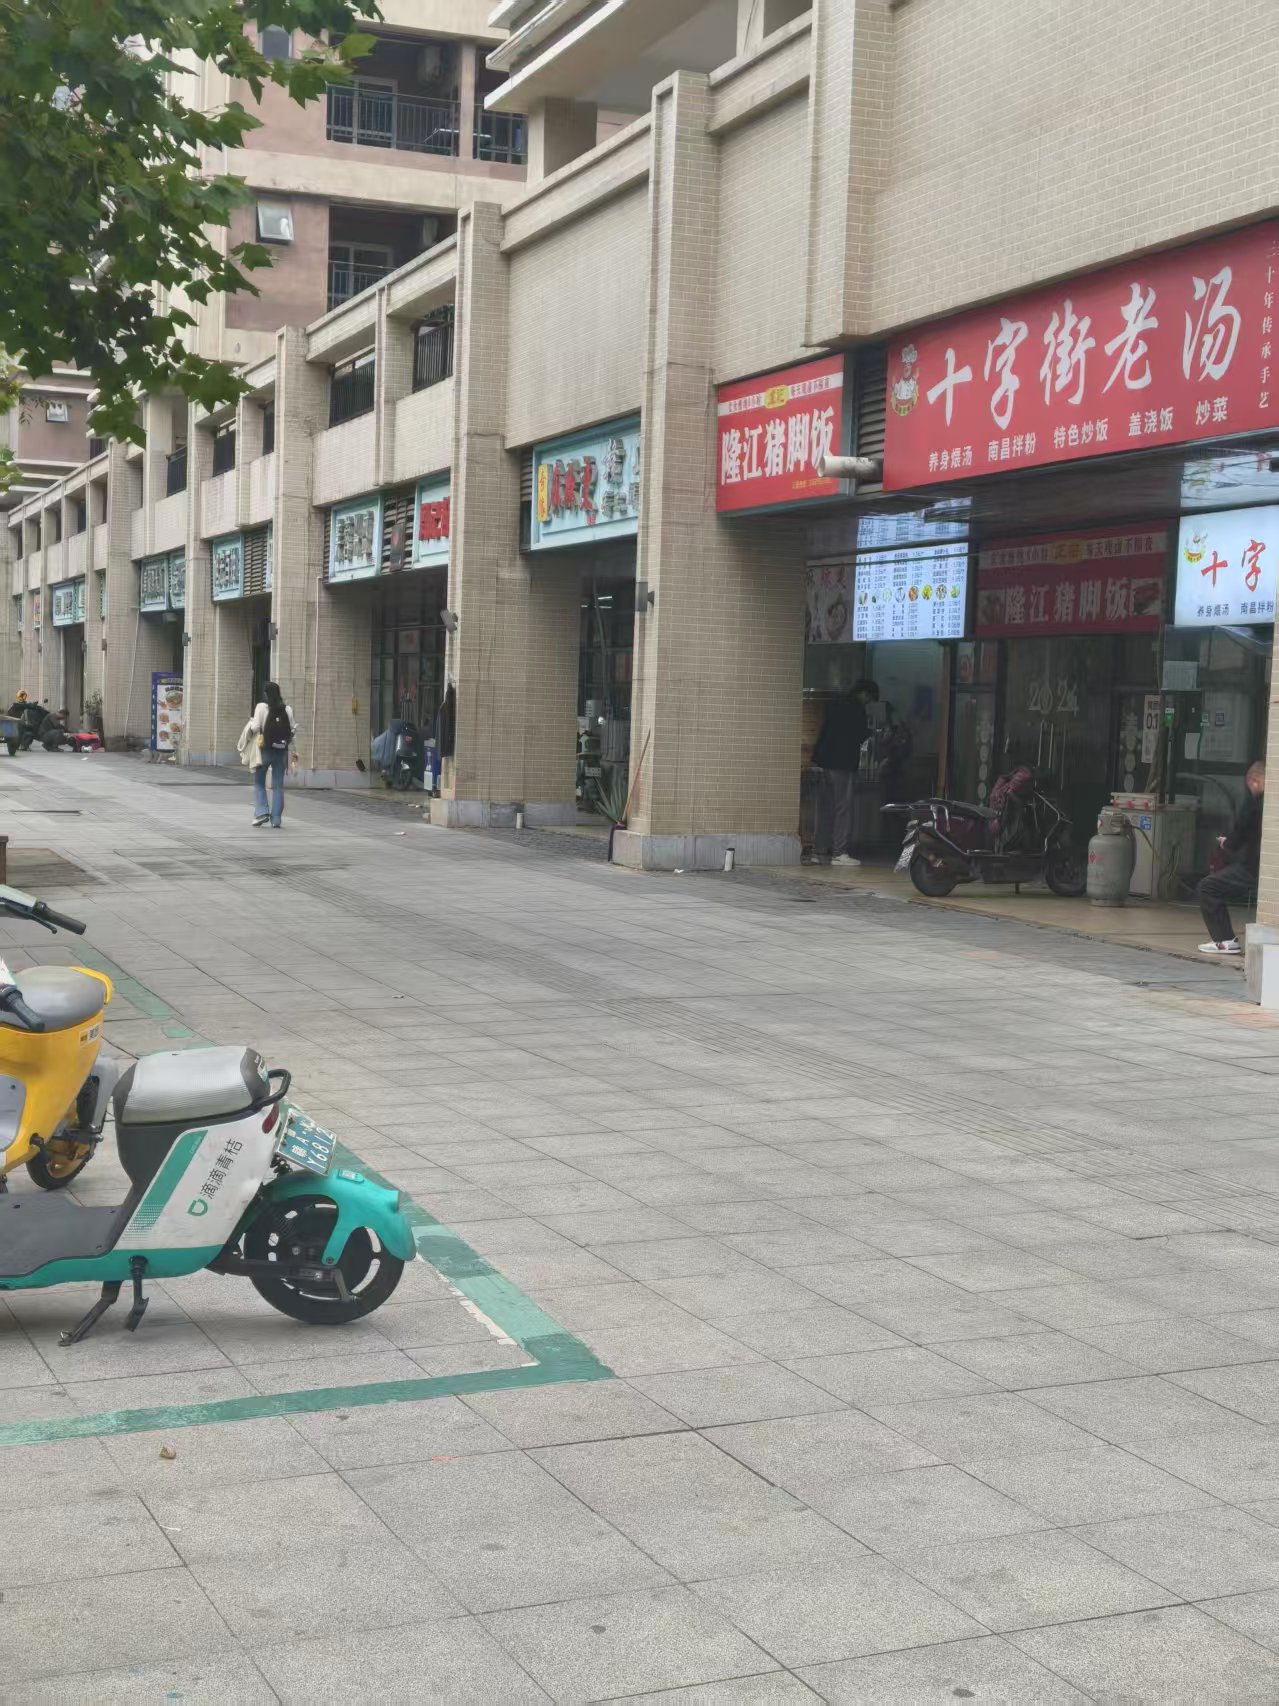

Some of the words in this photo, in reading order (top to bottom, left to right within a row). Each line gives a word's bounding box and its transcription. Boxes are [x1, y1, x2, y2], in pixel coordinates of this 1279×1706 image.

[926, 265, 1242, 430] 十字街老汤
[721, 406, 834, 486] 隆江猪脚饭
[928, 451, 973, 472] 养身煨汤
[987, 432, 1037, 462] 南昌拌粉
[1053, 418, 1109, 448] 特色炒饭
[1128, 406, 1174, 437] 盖浇饭
[1195, 396, 1229, 425] 炒菜
[1201, 539, 1266, 592] 十字
[1005, 576, 1129, 625] 隆江猪脚饭
[1240, 600, 1274, 615] 南昌拌粉
[200, 1138, 243, 1200] 滴滴青桔
